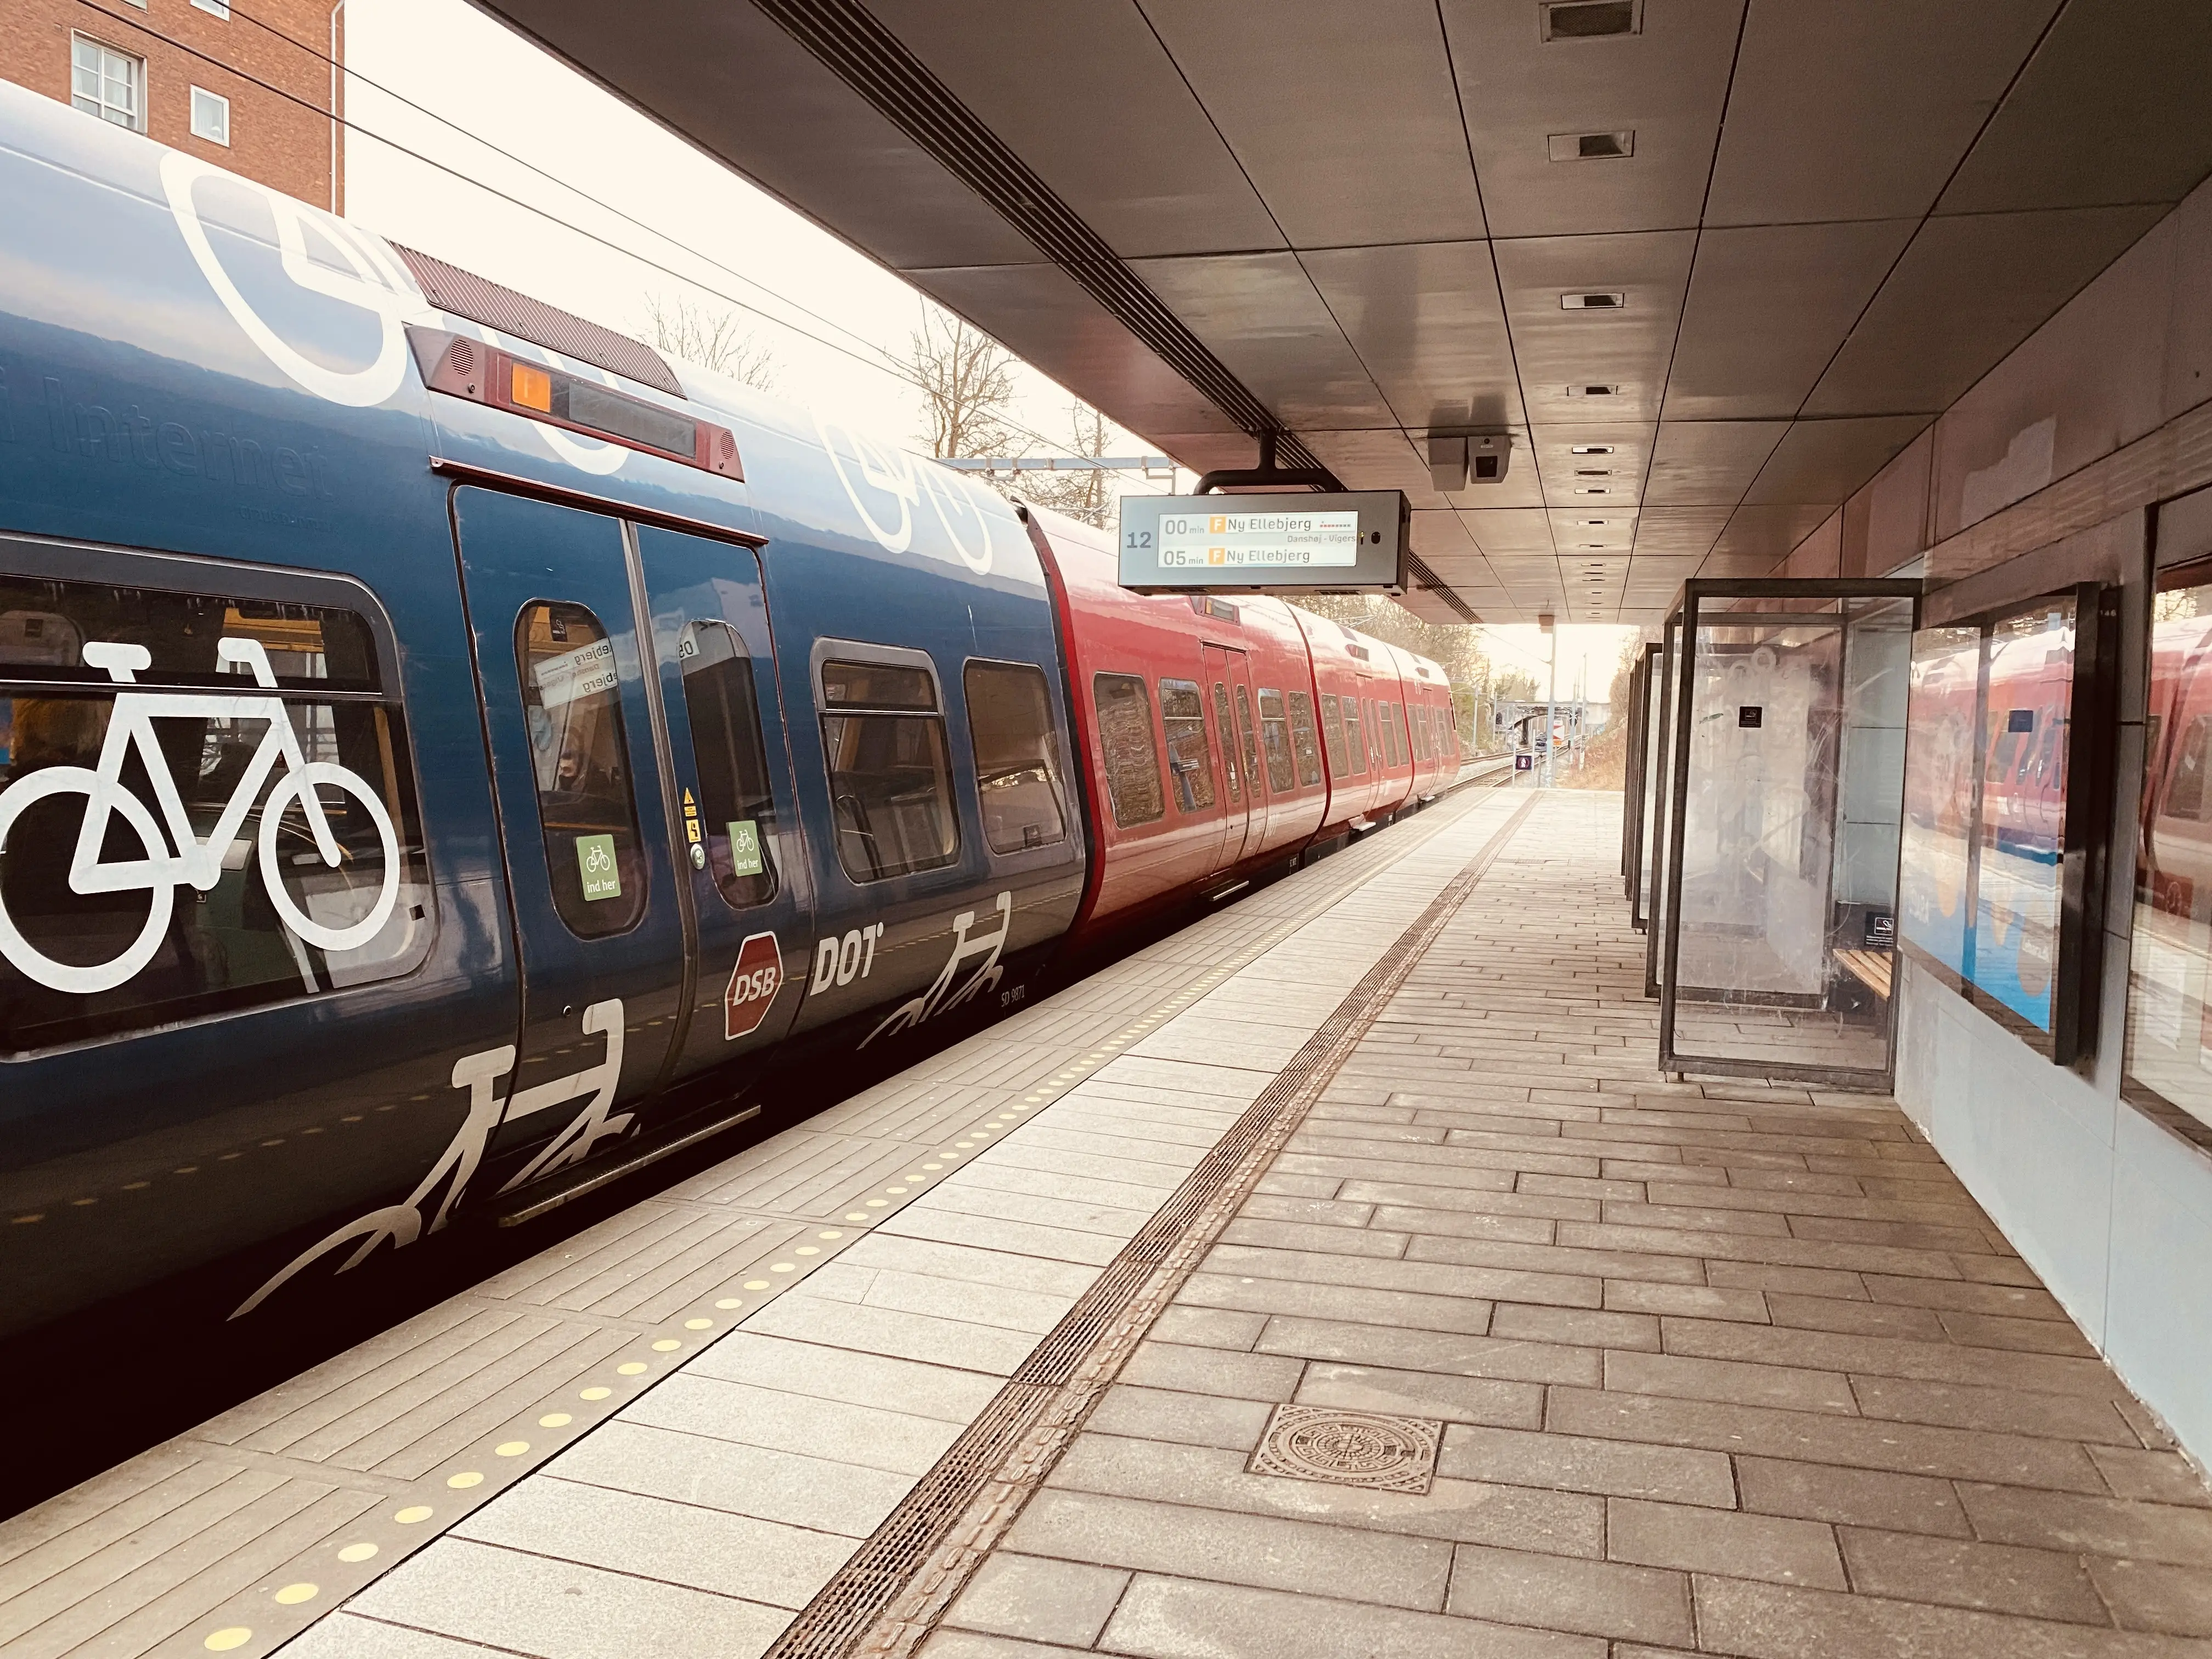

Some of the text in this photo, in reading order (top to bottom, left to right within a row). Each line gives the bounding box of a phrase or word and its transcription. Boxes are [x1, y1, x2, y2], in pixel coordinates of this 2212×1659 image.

[1165, 517, 1311, 535] 00 min F Ny Ellebjerg
[1127, 532, 1151, 548] 12
[1164, 549, 1310, 566] 05 min F Ny Ellebjerg
[737, 858, 758, 870] ind her
[586, 879, 616, 894] ind her
[810, 922, 884, 996] DOT
[732, 967, 776, 1006] DSB
[1001, 984, 1025, 1007] SD 9871
